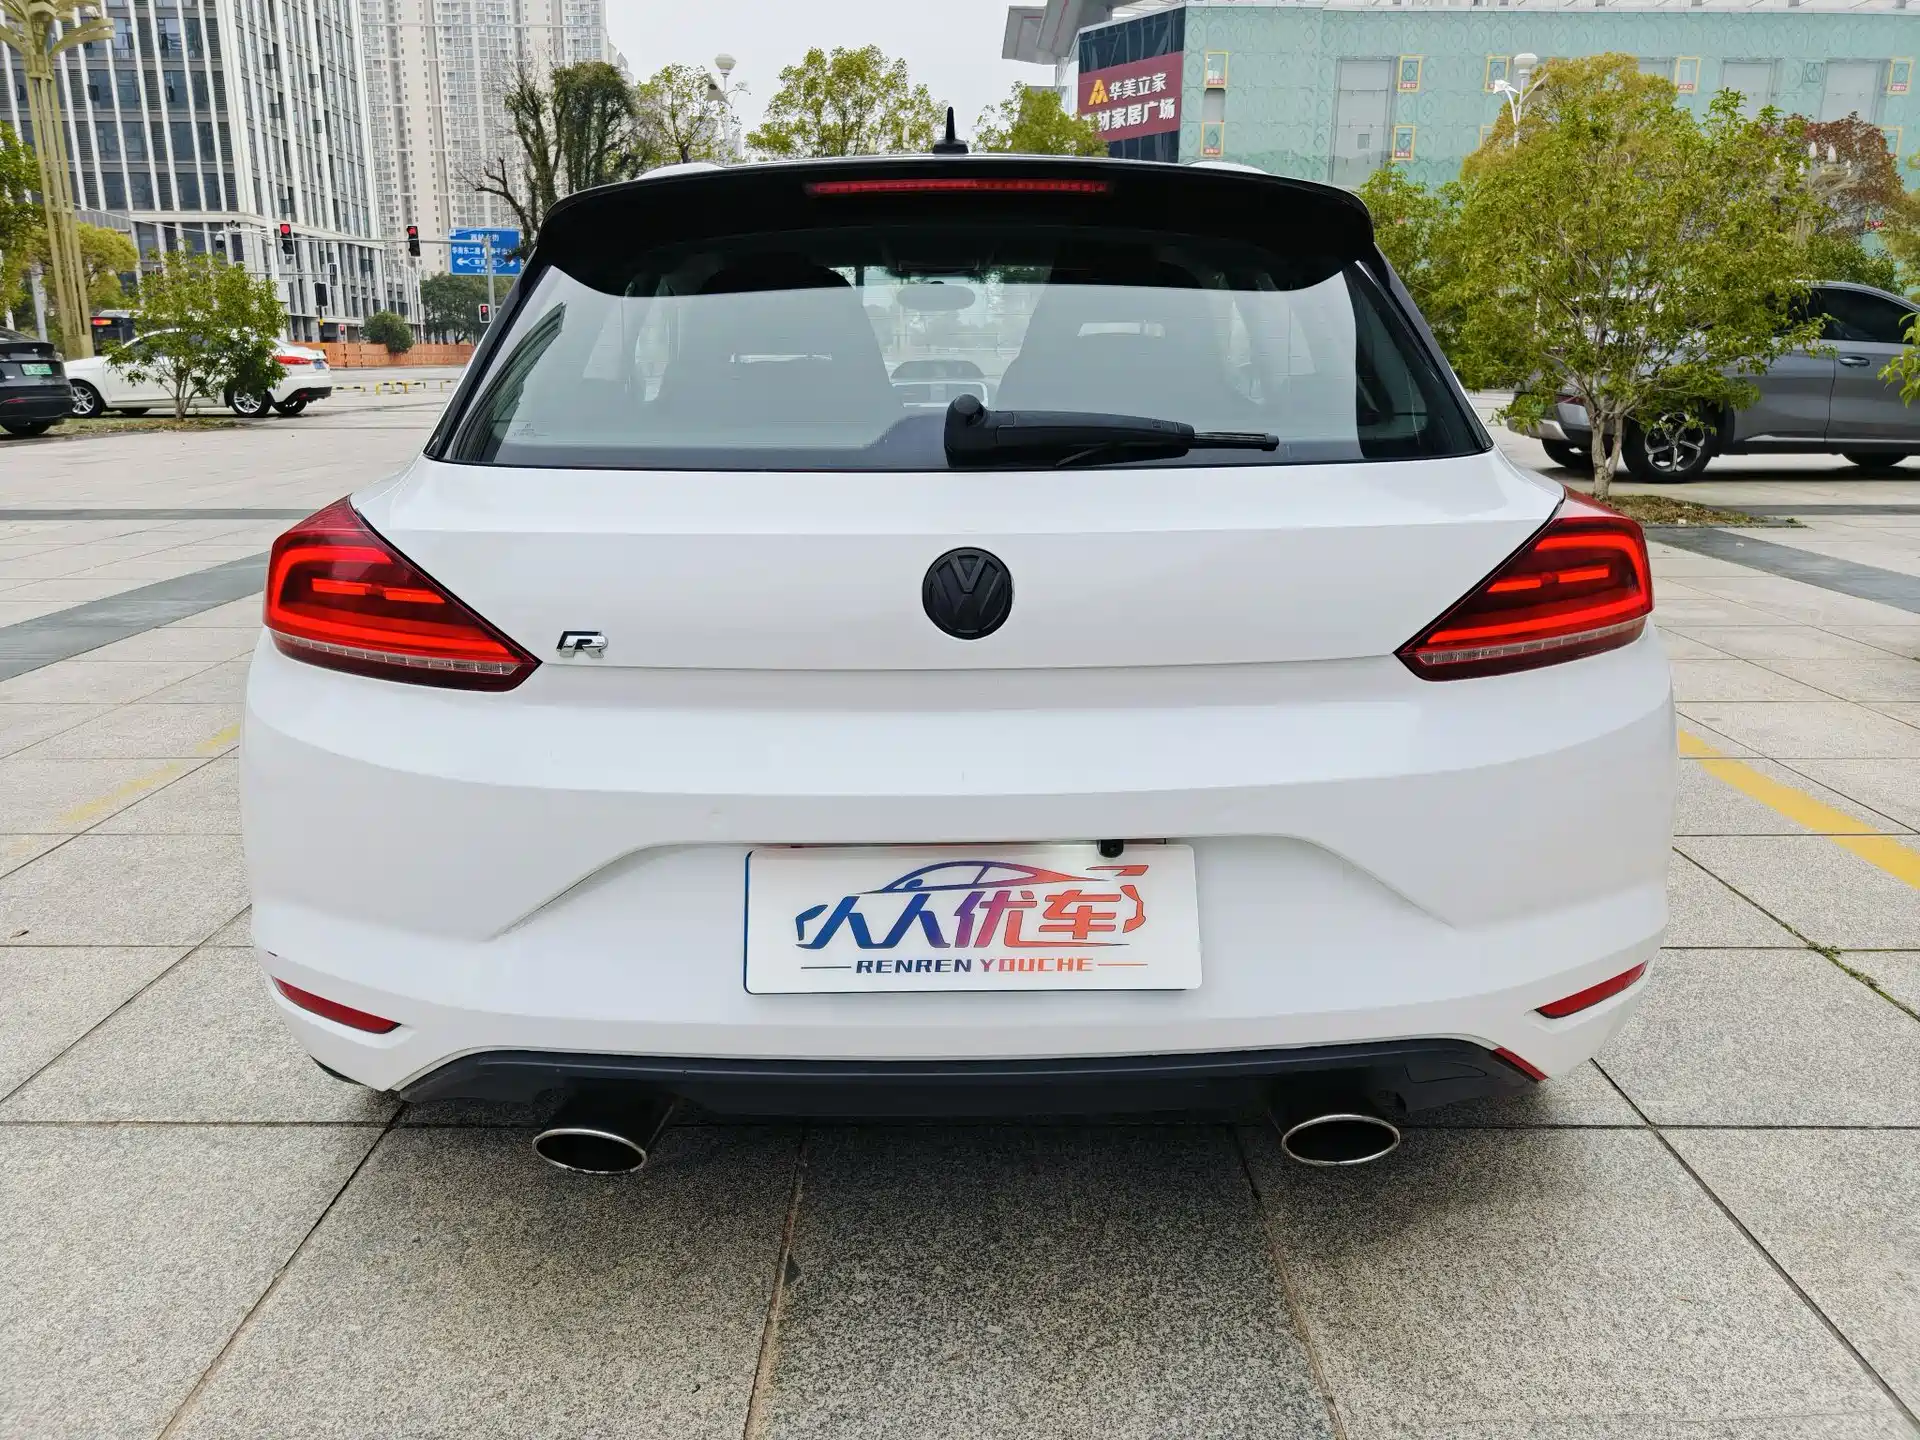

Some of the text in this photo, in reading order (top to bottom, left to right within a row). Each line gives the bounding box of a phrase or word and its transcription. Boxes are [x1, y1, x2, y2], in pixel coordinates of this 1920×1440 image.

[1109, 72, 1167, 101] 华美立家
[556, 630, 608, 658] R
[796, 889, 1126, 949] 人人优车
[856, 957, 1094, 974] RENREN YOUCHE
